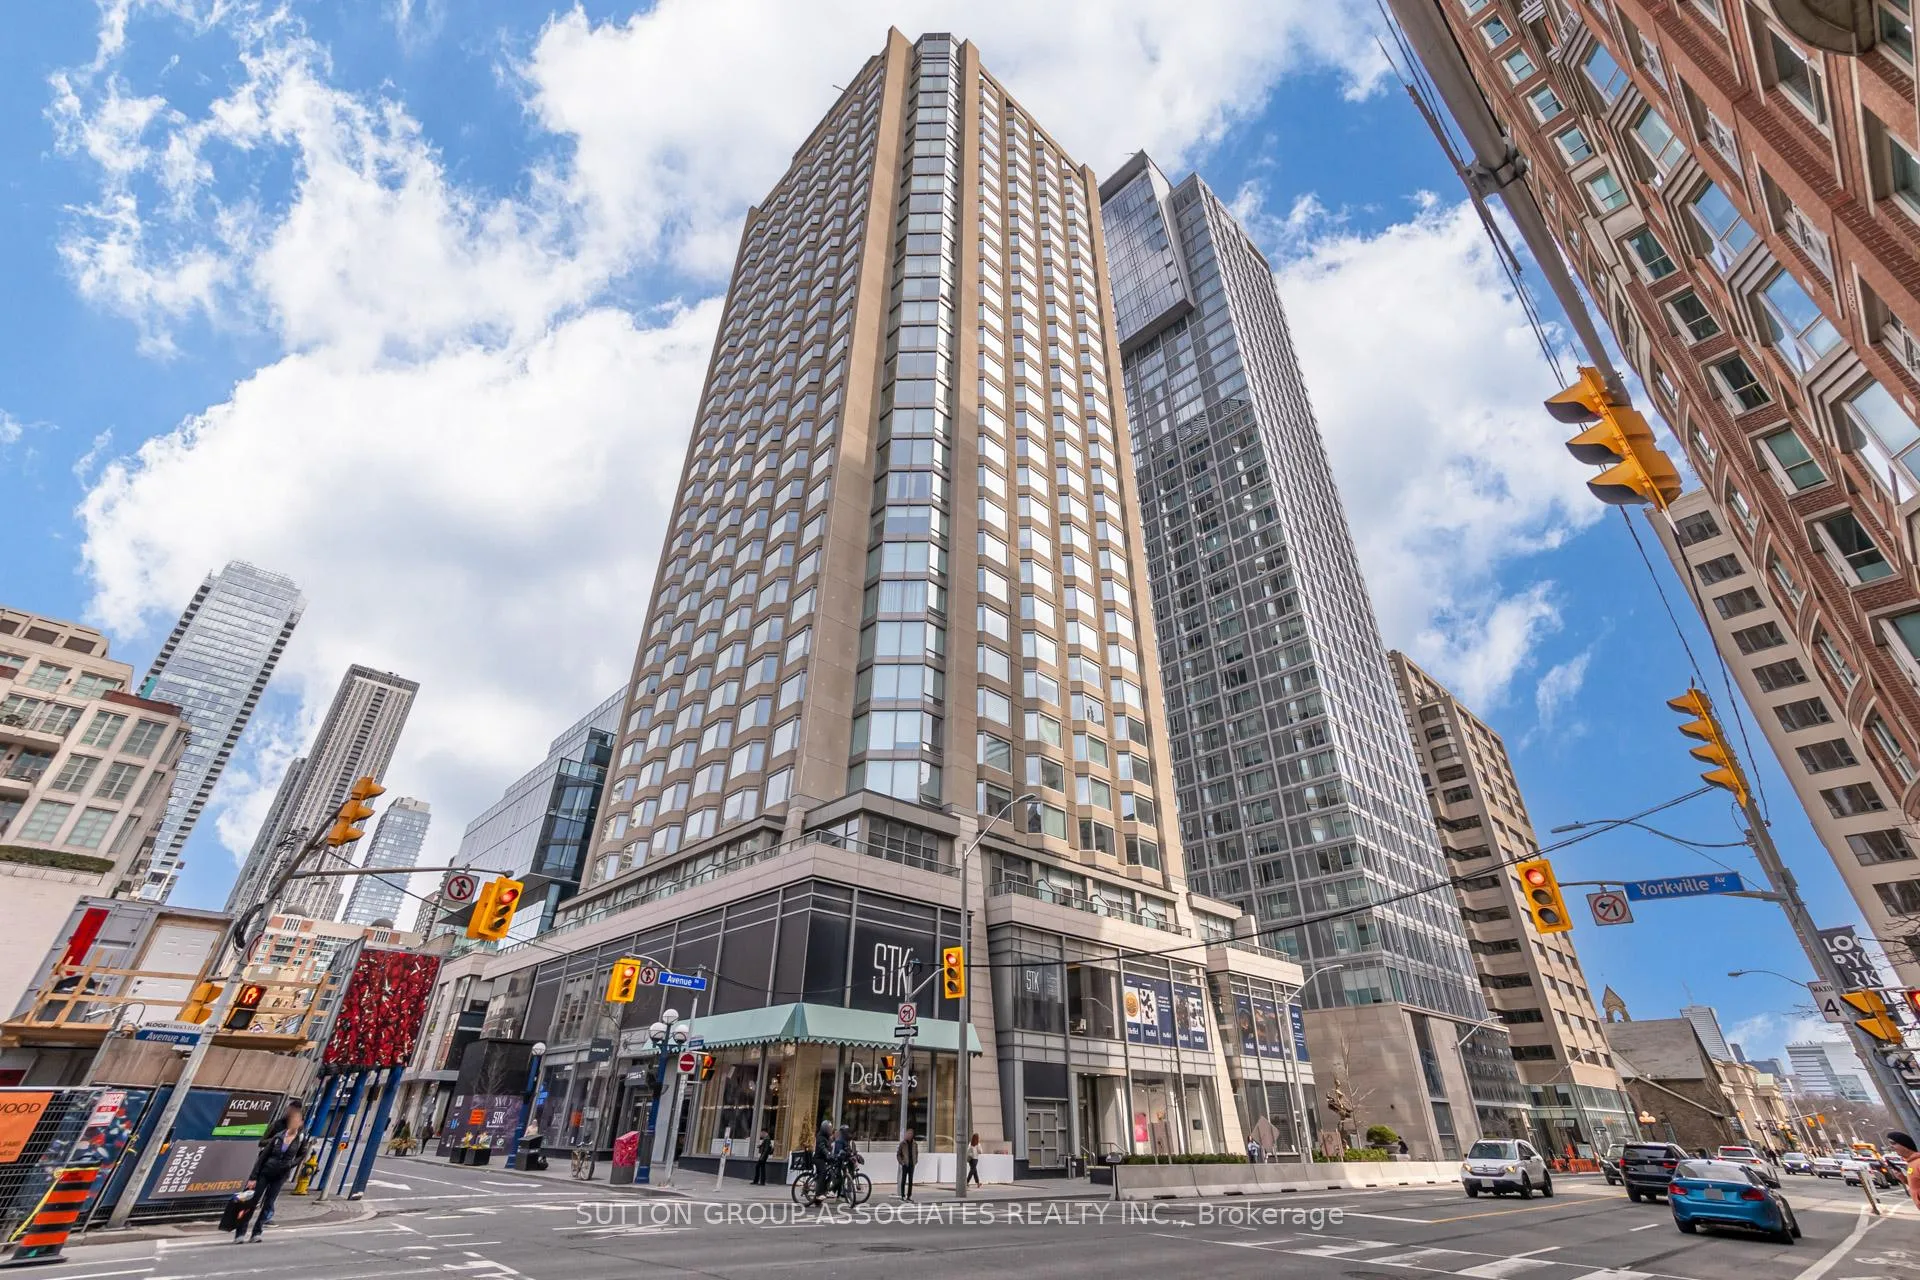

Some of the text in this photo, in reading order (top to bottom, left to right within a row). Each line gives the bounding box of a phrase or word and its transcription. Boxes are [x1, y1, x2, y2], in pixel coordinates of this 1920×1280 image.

[1637, 879, 1709, 896] Yorkville
[667, 975, 692, 986] Avenue
[872, 943, 911, 996] STK
[1026, 970, 1039, 993] STK
[146, 1031, 179, 1042] Avenue
[158, 1146, 188, 1193] BRISBIN
[168, 1151, 195, 1193] BROOK
[177, 1145, 207, 1192] BEYNON
[187, 1180, 242, 1192] ARCHITECTS
